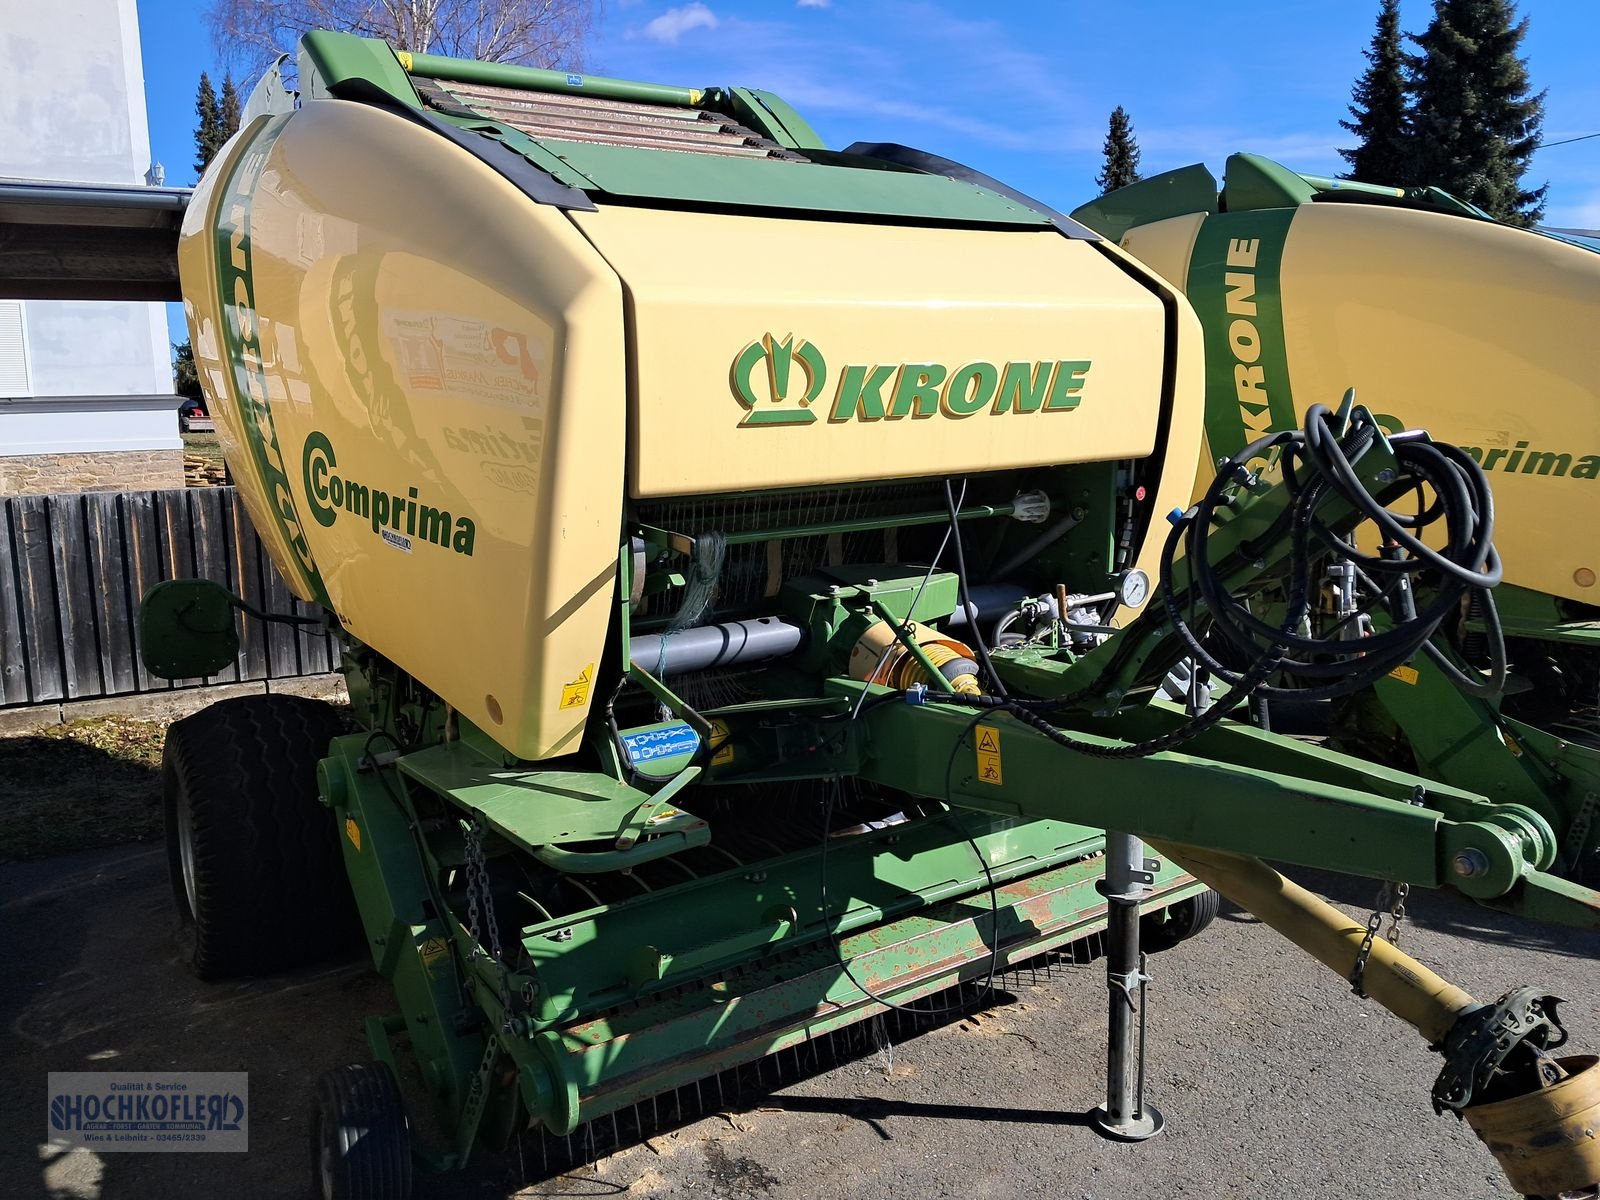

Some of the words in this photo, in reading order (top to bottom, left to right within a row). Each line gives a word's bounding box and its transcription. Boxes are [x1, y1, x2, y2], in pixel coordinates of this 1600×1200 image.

[827, 360, 1092, 424] KRONE
[1225, 238, 1272, 446] KRONE
[303, 431, 476, 557] Comprima
